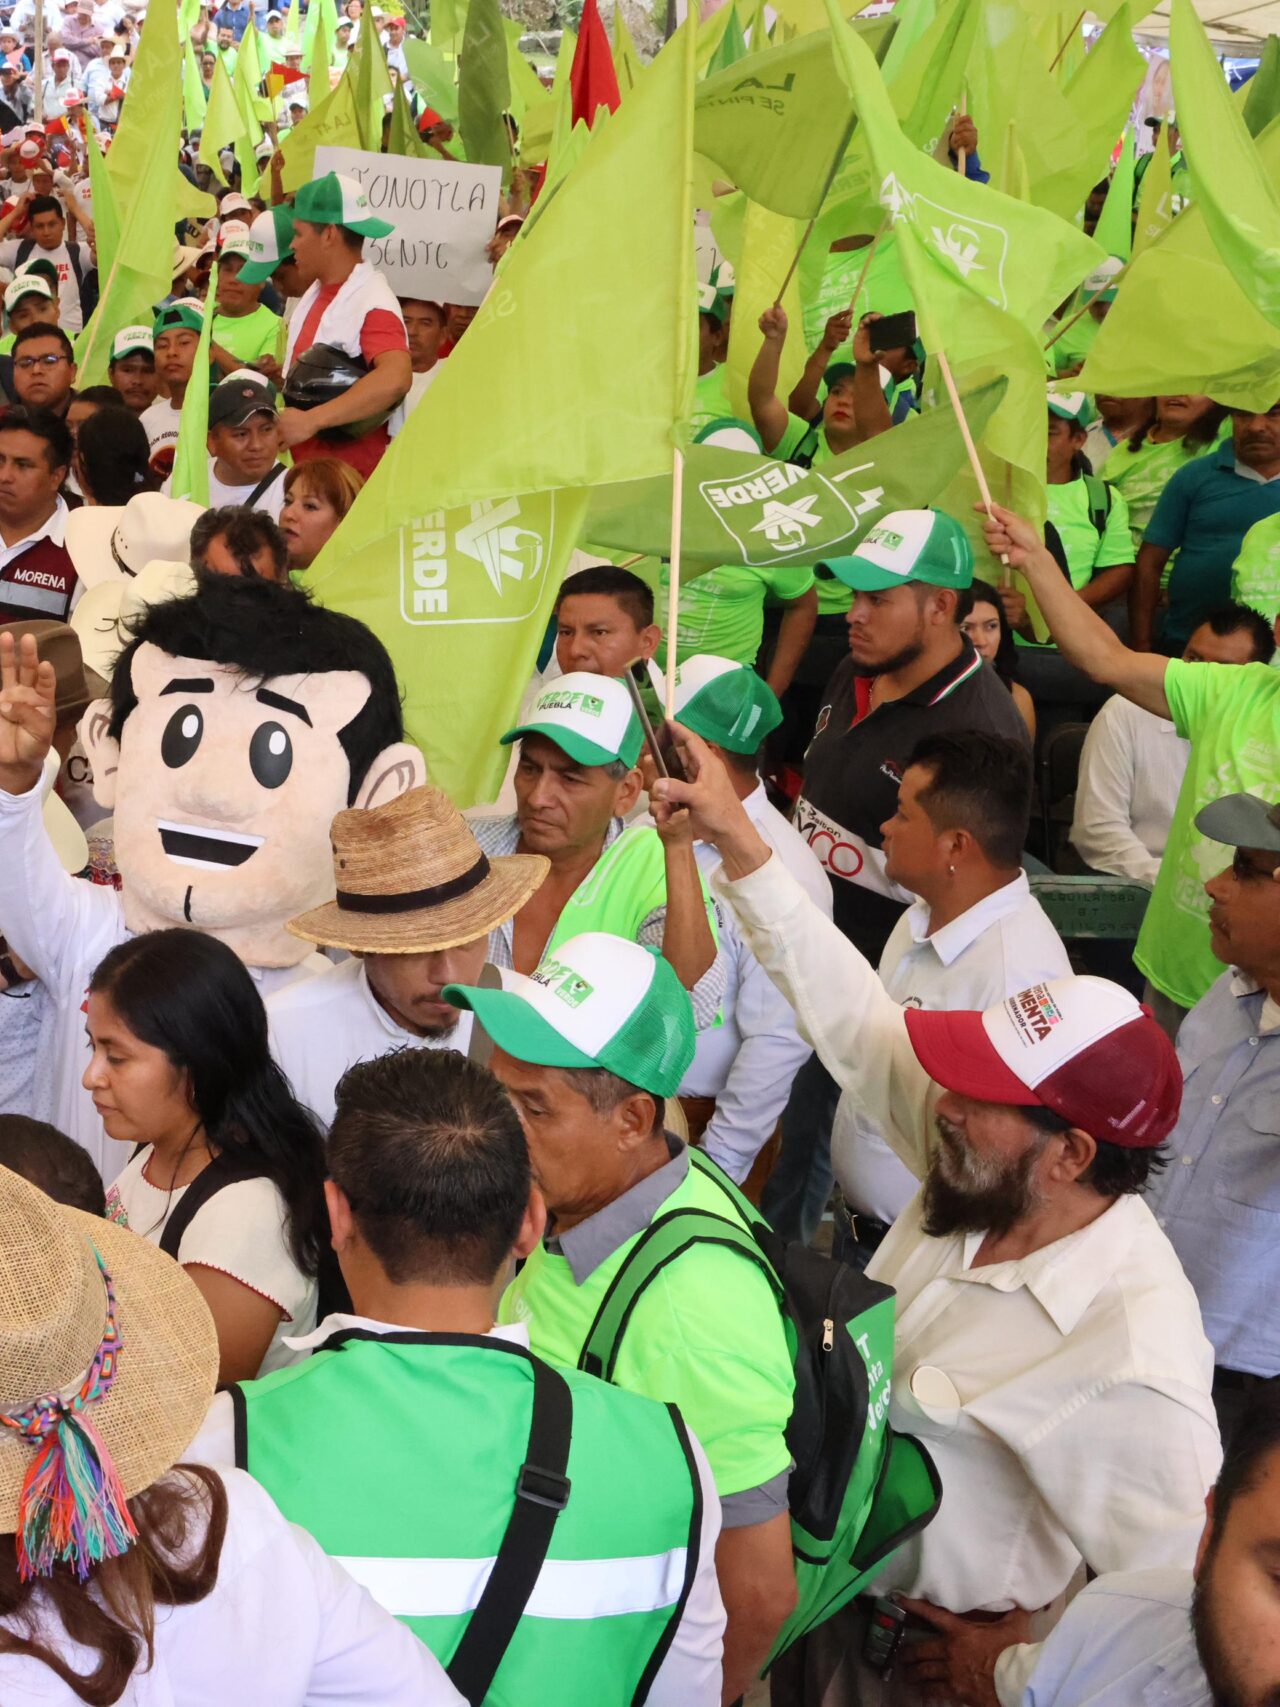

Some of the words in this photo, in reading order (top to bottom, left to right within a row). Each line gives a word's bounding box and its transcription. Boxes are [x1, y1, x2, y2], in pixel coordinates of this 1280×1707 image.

[369, 237, 448, 269] SENTE
[707, 462, 810, 509] VERDE
[14, 567, 66, 590] MORENA
[412, 509, 449, 614] ERDE
[538, 701, 573, 712] PUEBLA
[1018, 987, 1053, 1042] MENTA
[867, 1360, 884, 1392] nta
[867, 1378, 892, 1431] Verd
